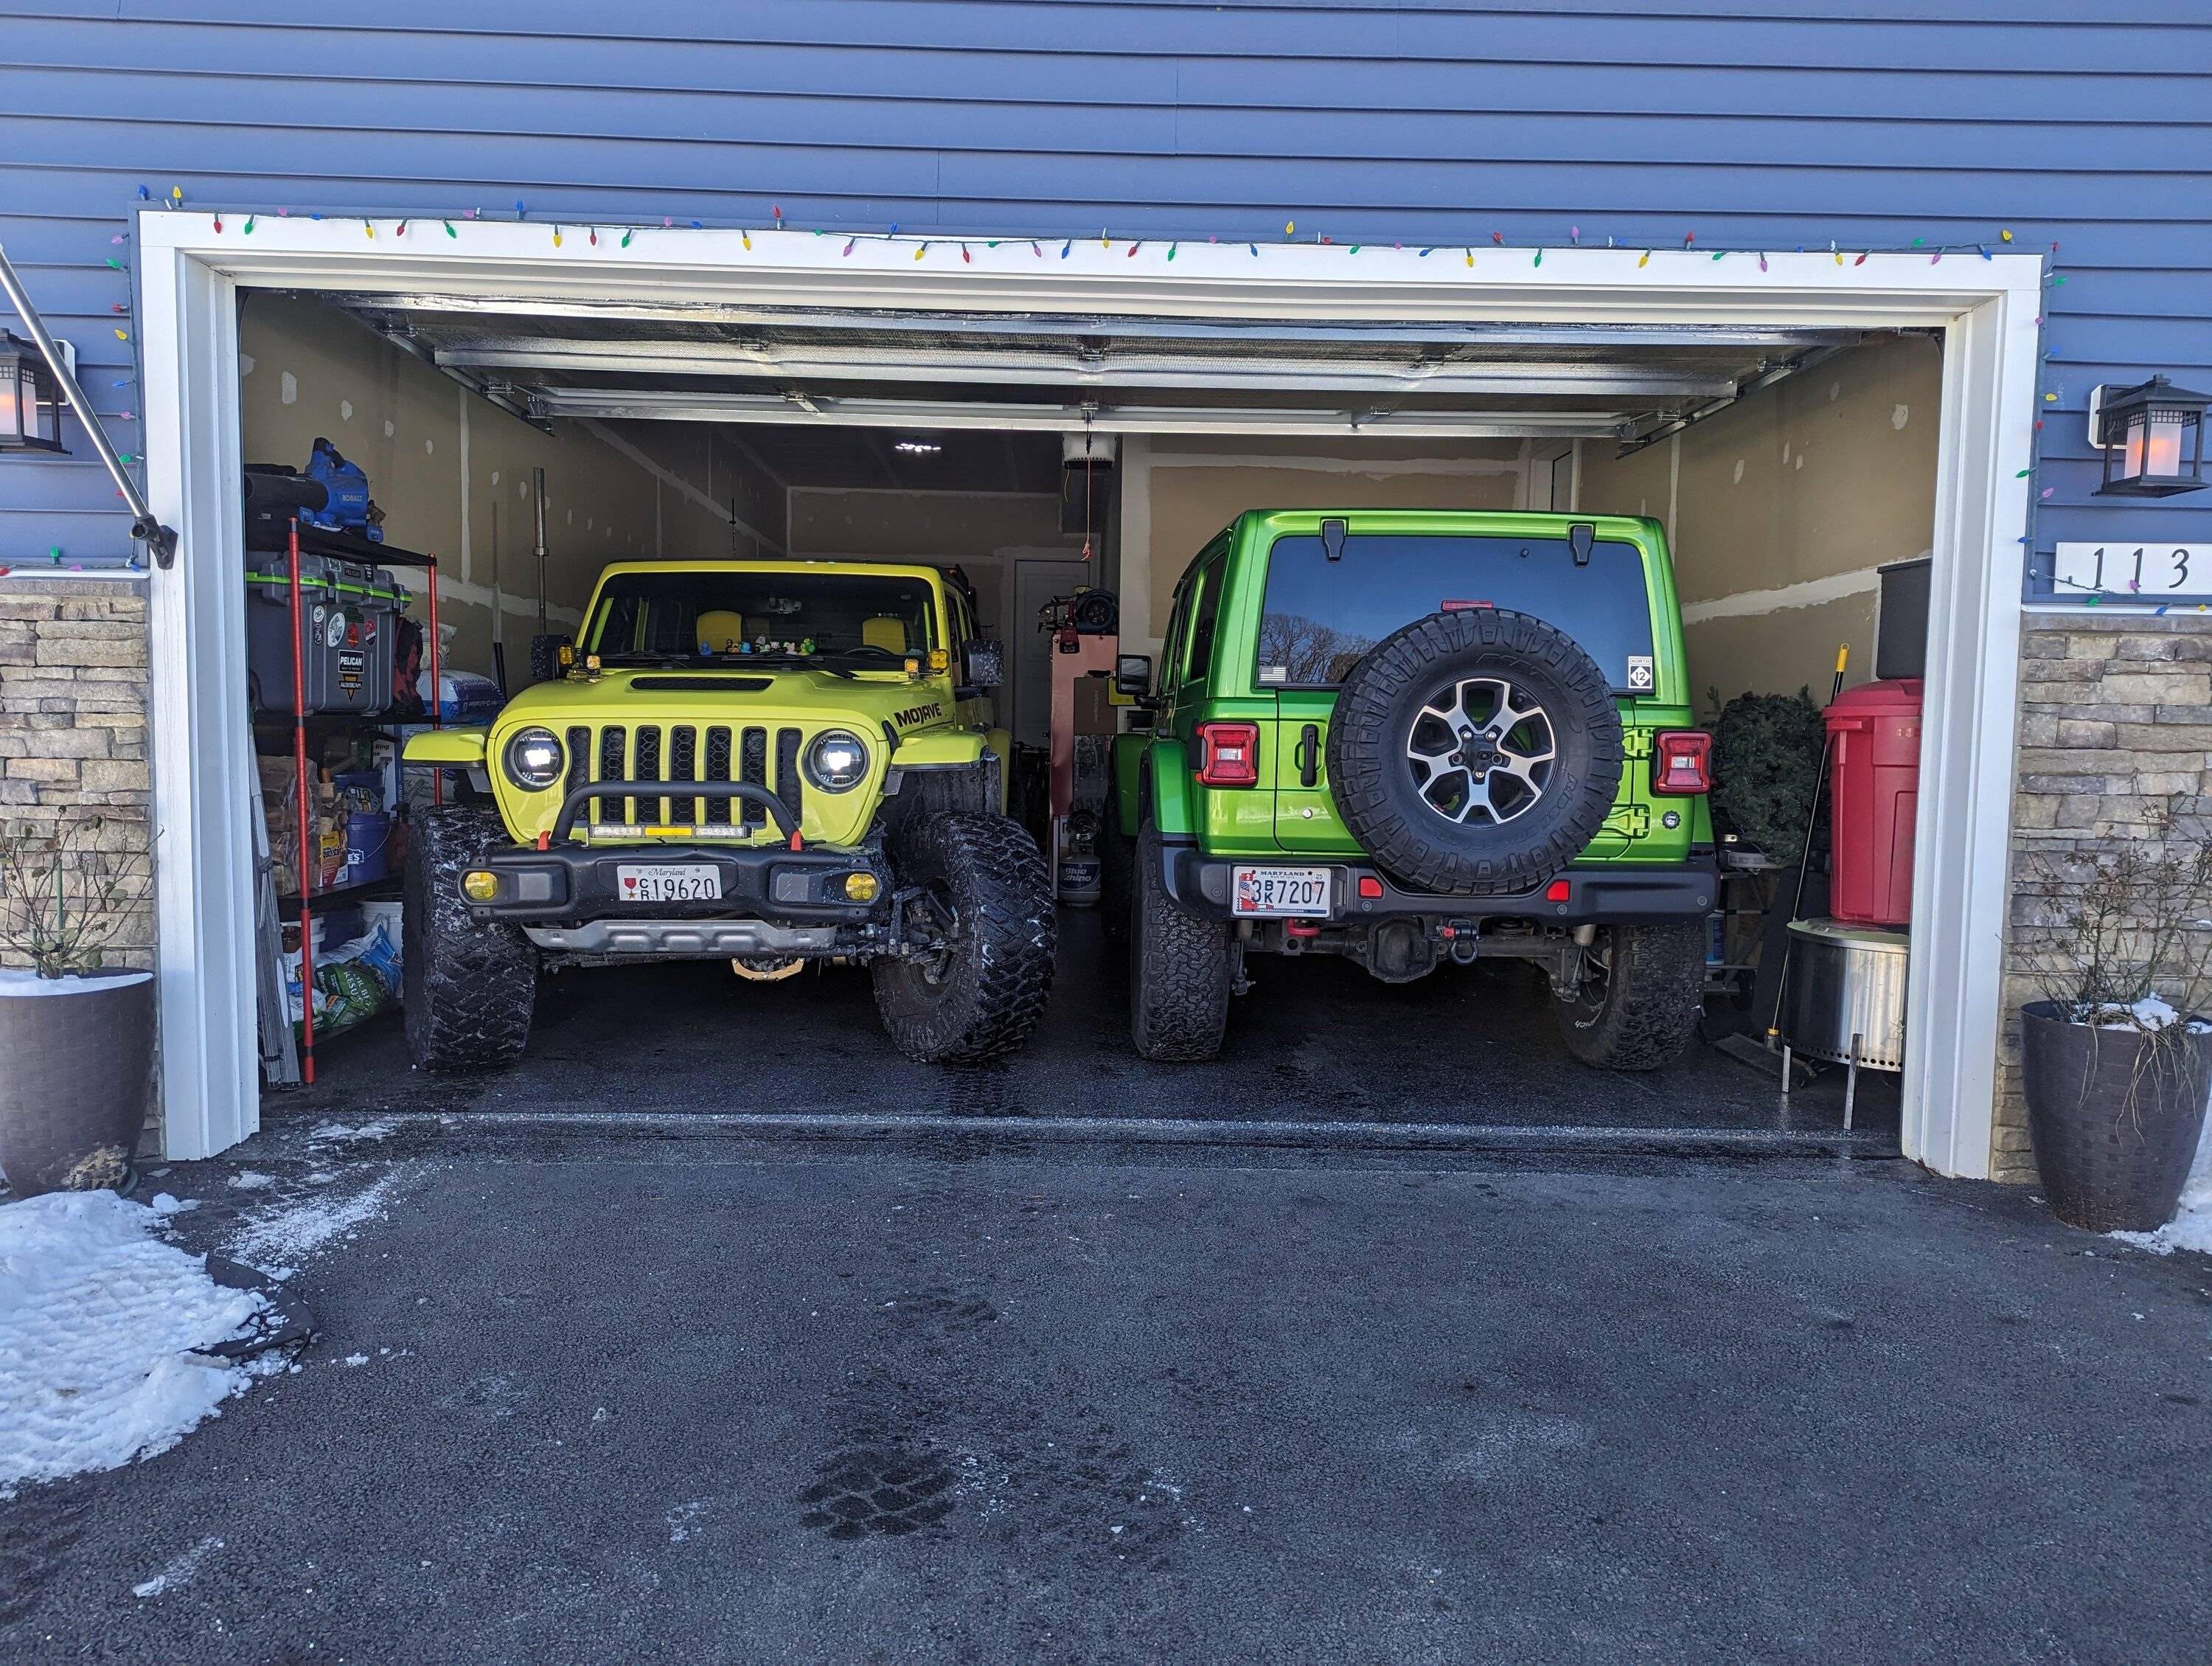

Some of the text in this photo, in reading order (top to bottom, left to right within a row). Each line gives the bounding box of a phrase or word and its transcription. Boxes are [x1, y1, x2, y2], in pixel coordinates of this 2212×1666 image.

[345, 569, 361, 577] PELICAN
[2094, 547, 2189, 589] 113
[340, 656, 363, 666] PELICAN
[1635, 672, 1646, 681] 12
[893, 702, 942, 728] MOJAVE
[648, 867, 686, 878] Maryland
